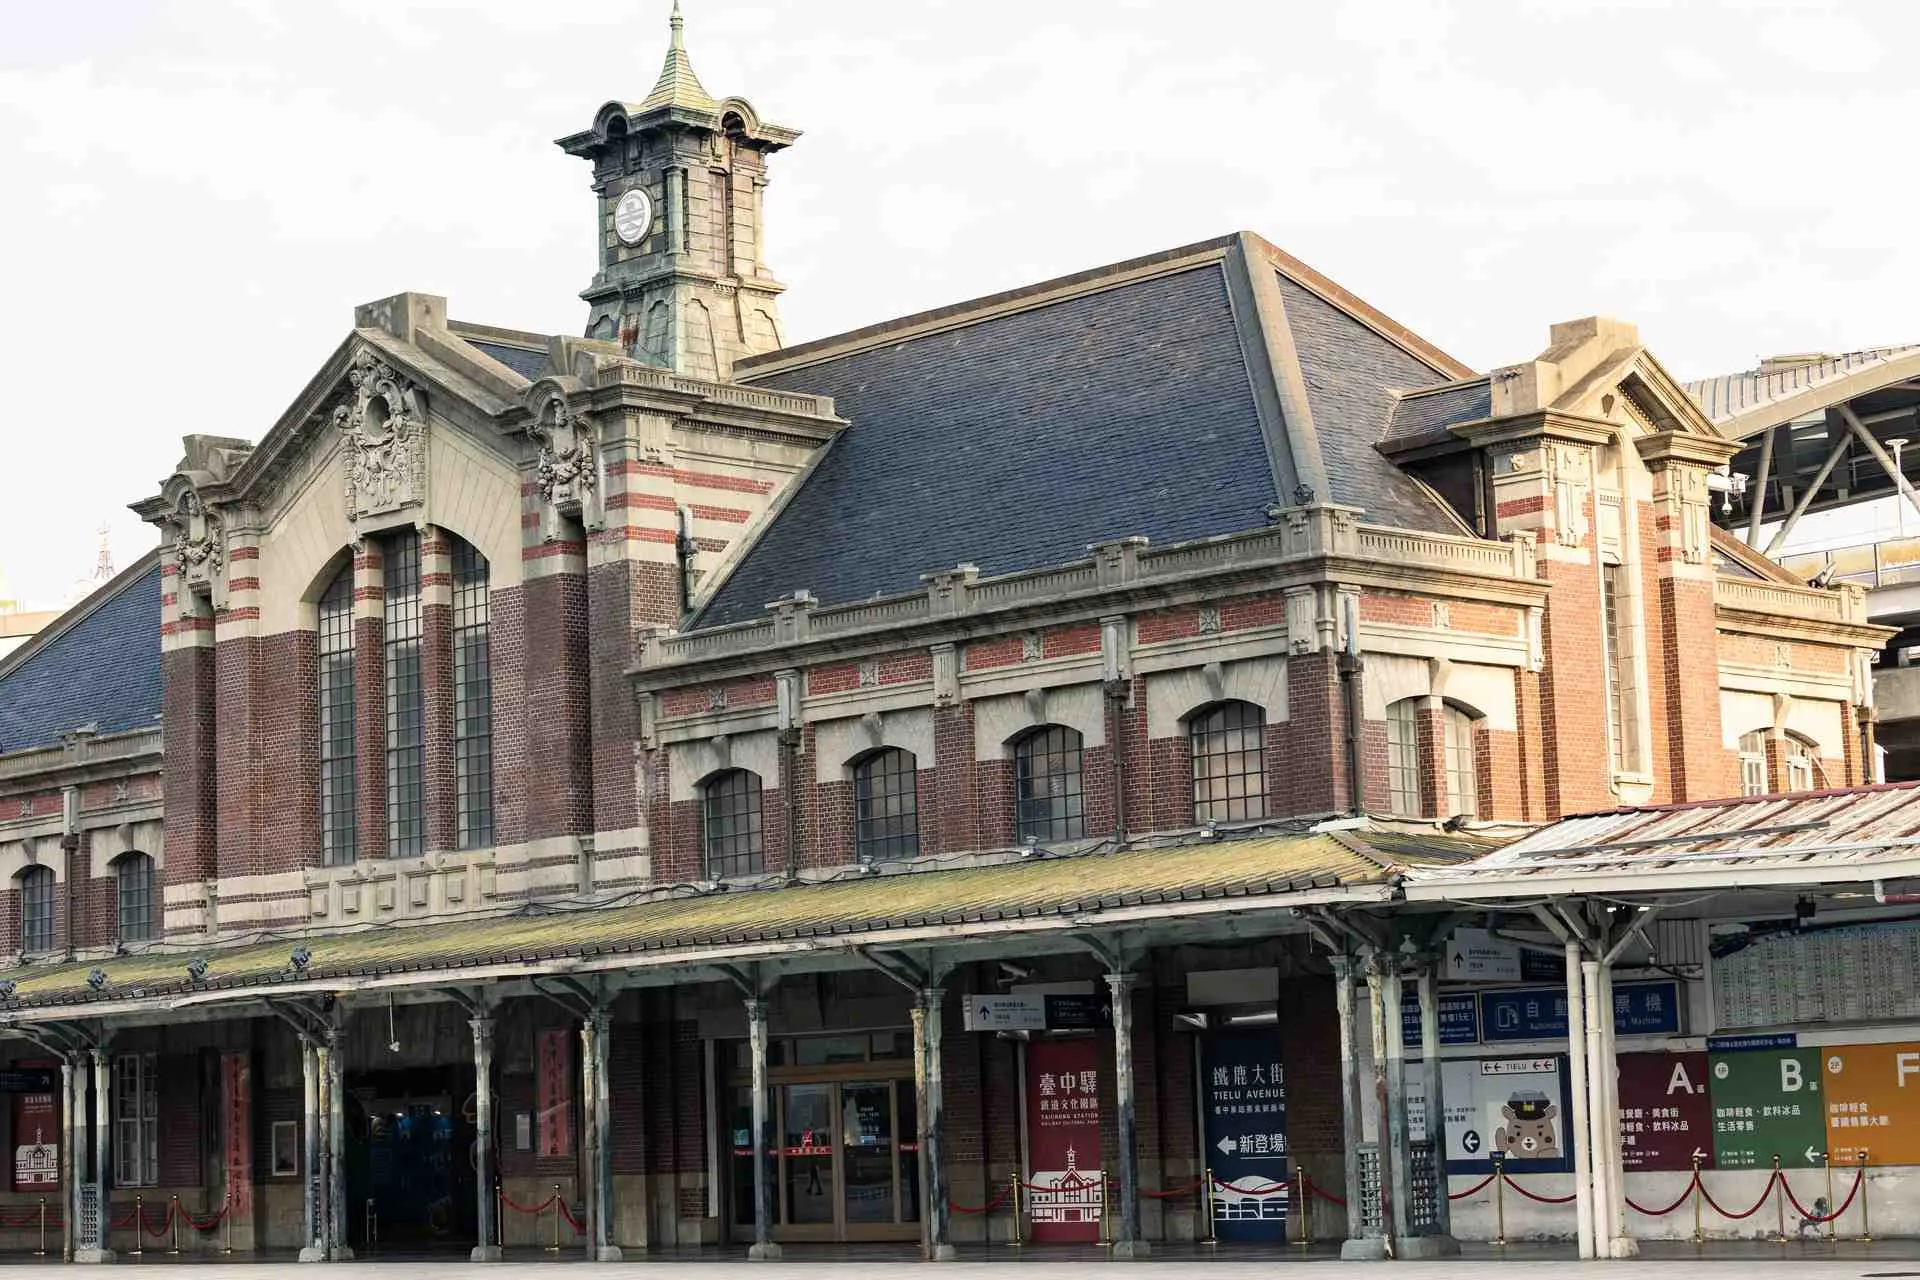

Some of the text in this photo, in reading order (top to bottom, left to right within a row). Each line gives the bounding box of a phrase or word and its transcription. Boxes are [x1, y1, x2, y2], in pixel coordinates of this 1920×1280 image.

[1040, 1070, 1097, 1096] 臺中驛
[1213, 1063, 1284, 1087] 鐵鹿大街
[1667, 1062, 1694, 1095] A
[1781, 1059, 1802, 1092] B
[1214, 1088, 1286, 1101] TIELU AVENUE
